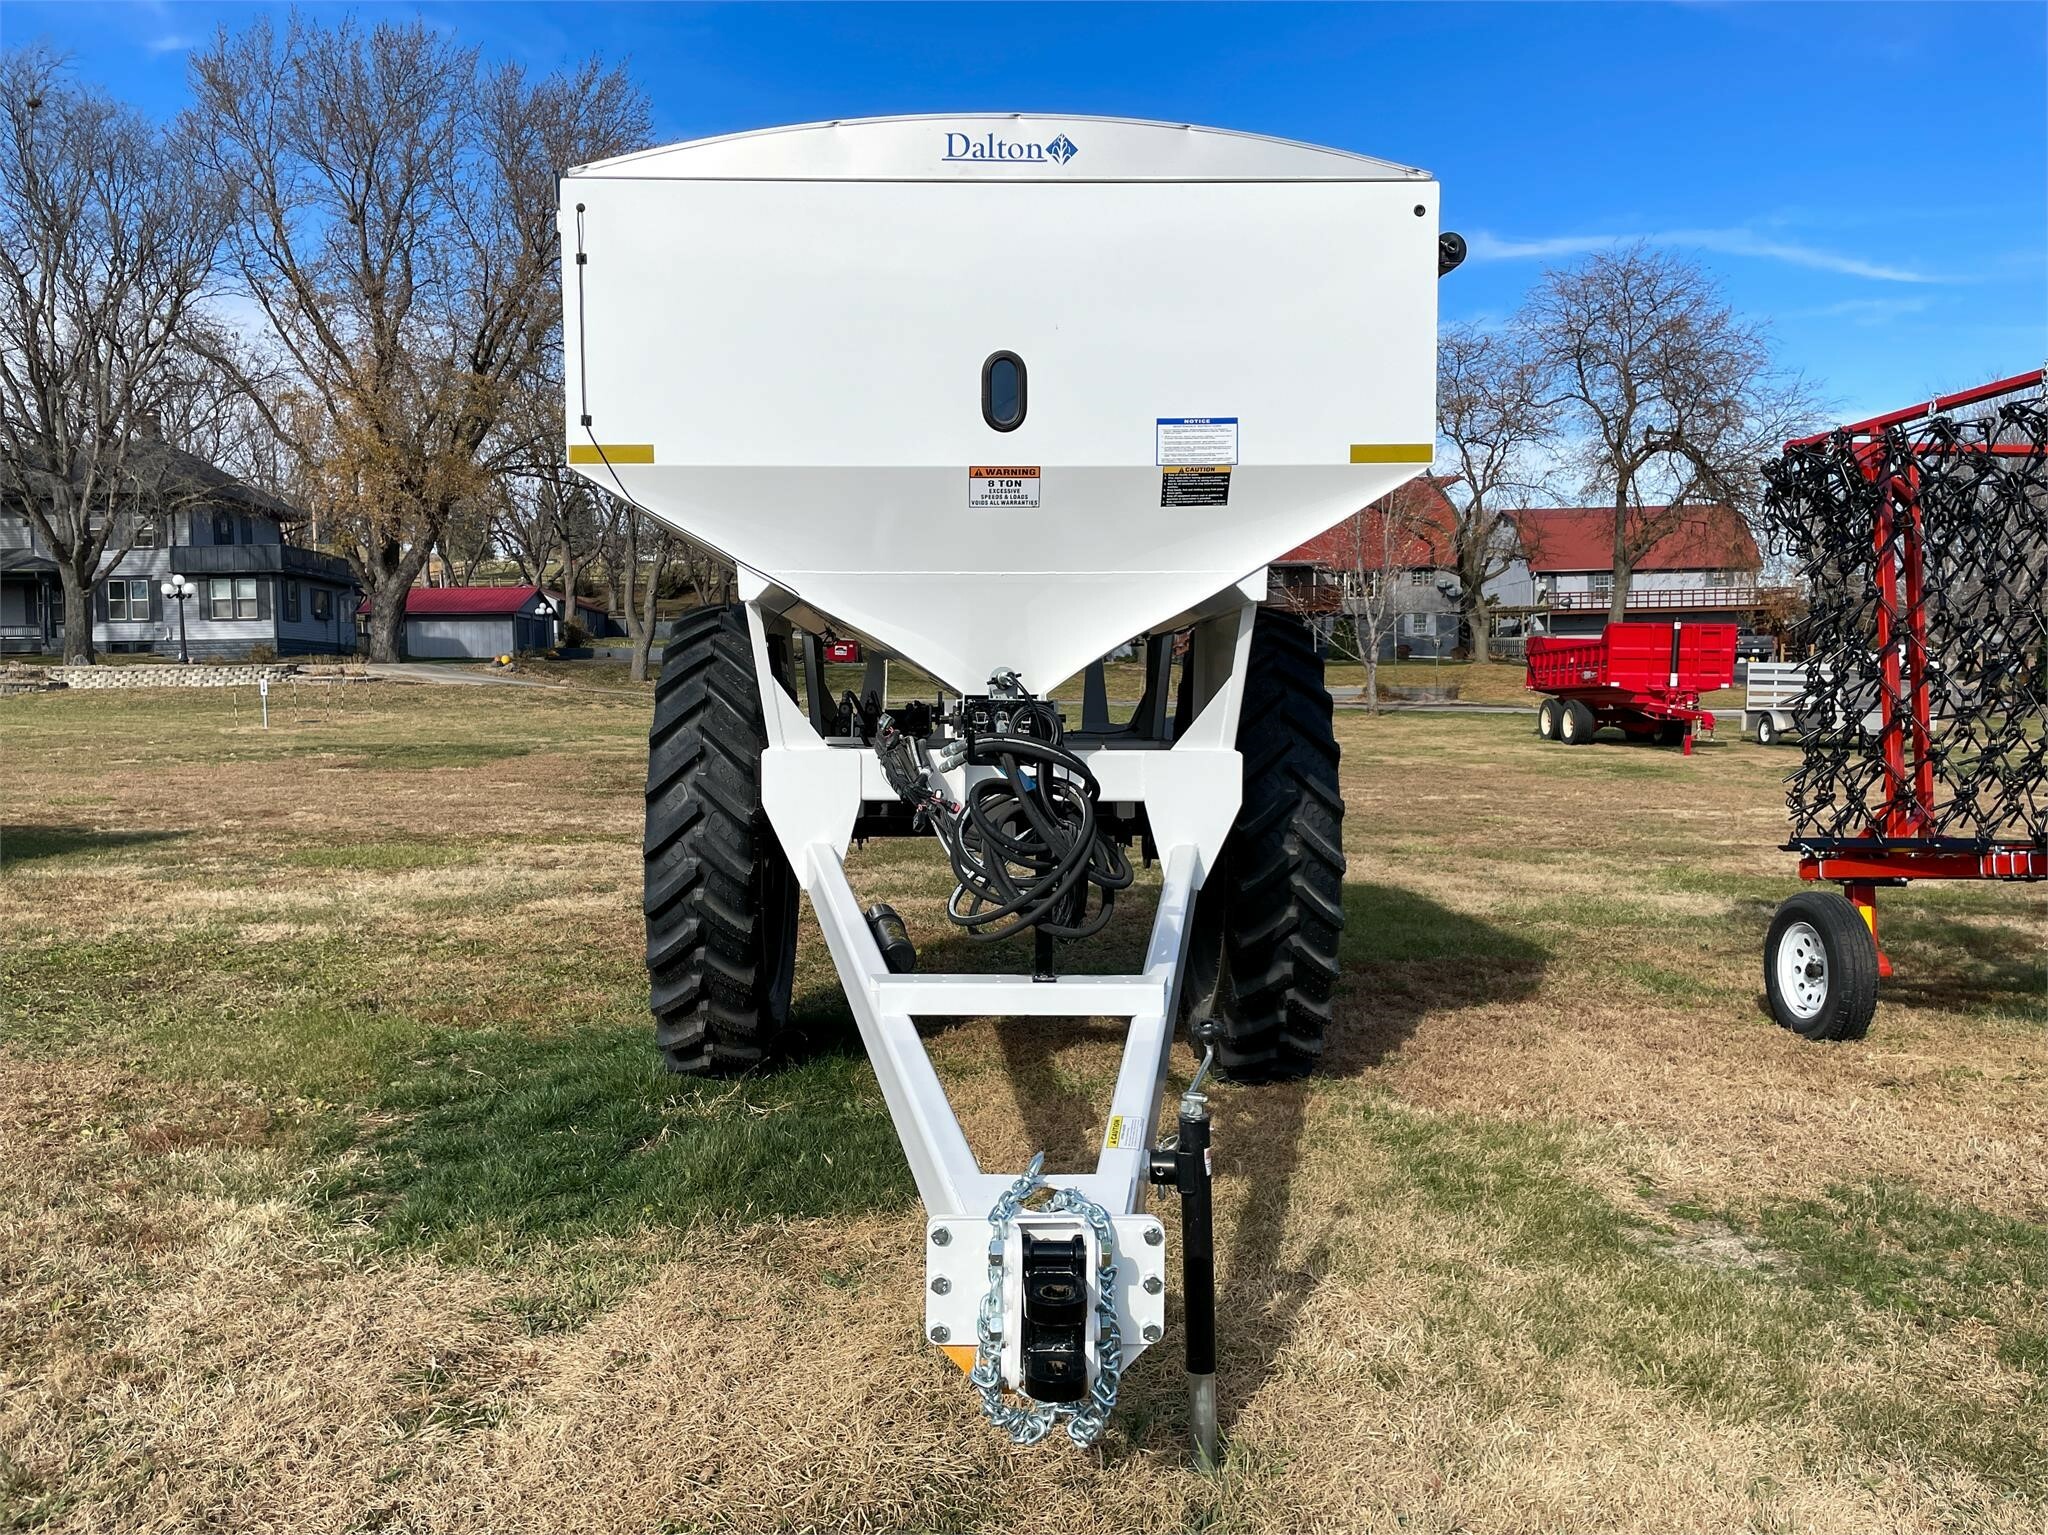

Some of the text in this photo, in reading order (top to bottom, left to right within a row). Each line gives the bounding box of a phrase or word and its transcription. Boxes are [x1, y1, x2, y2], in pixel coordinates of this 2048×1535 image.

[944, 132, 1045, 159] Dalton
[985, 468, 1036, 476] WARNING
[988, 480, 1022, 488] 8 TON
[1110, 1119, 1120, 1140] CAUTION
